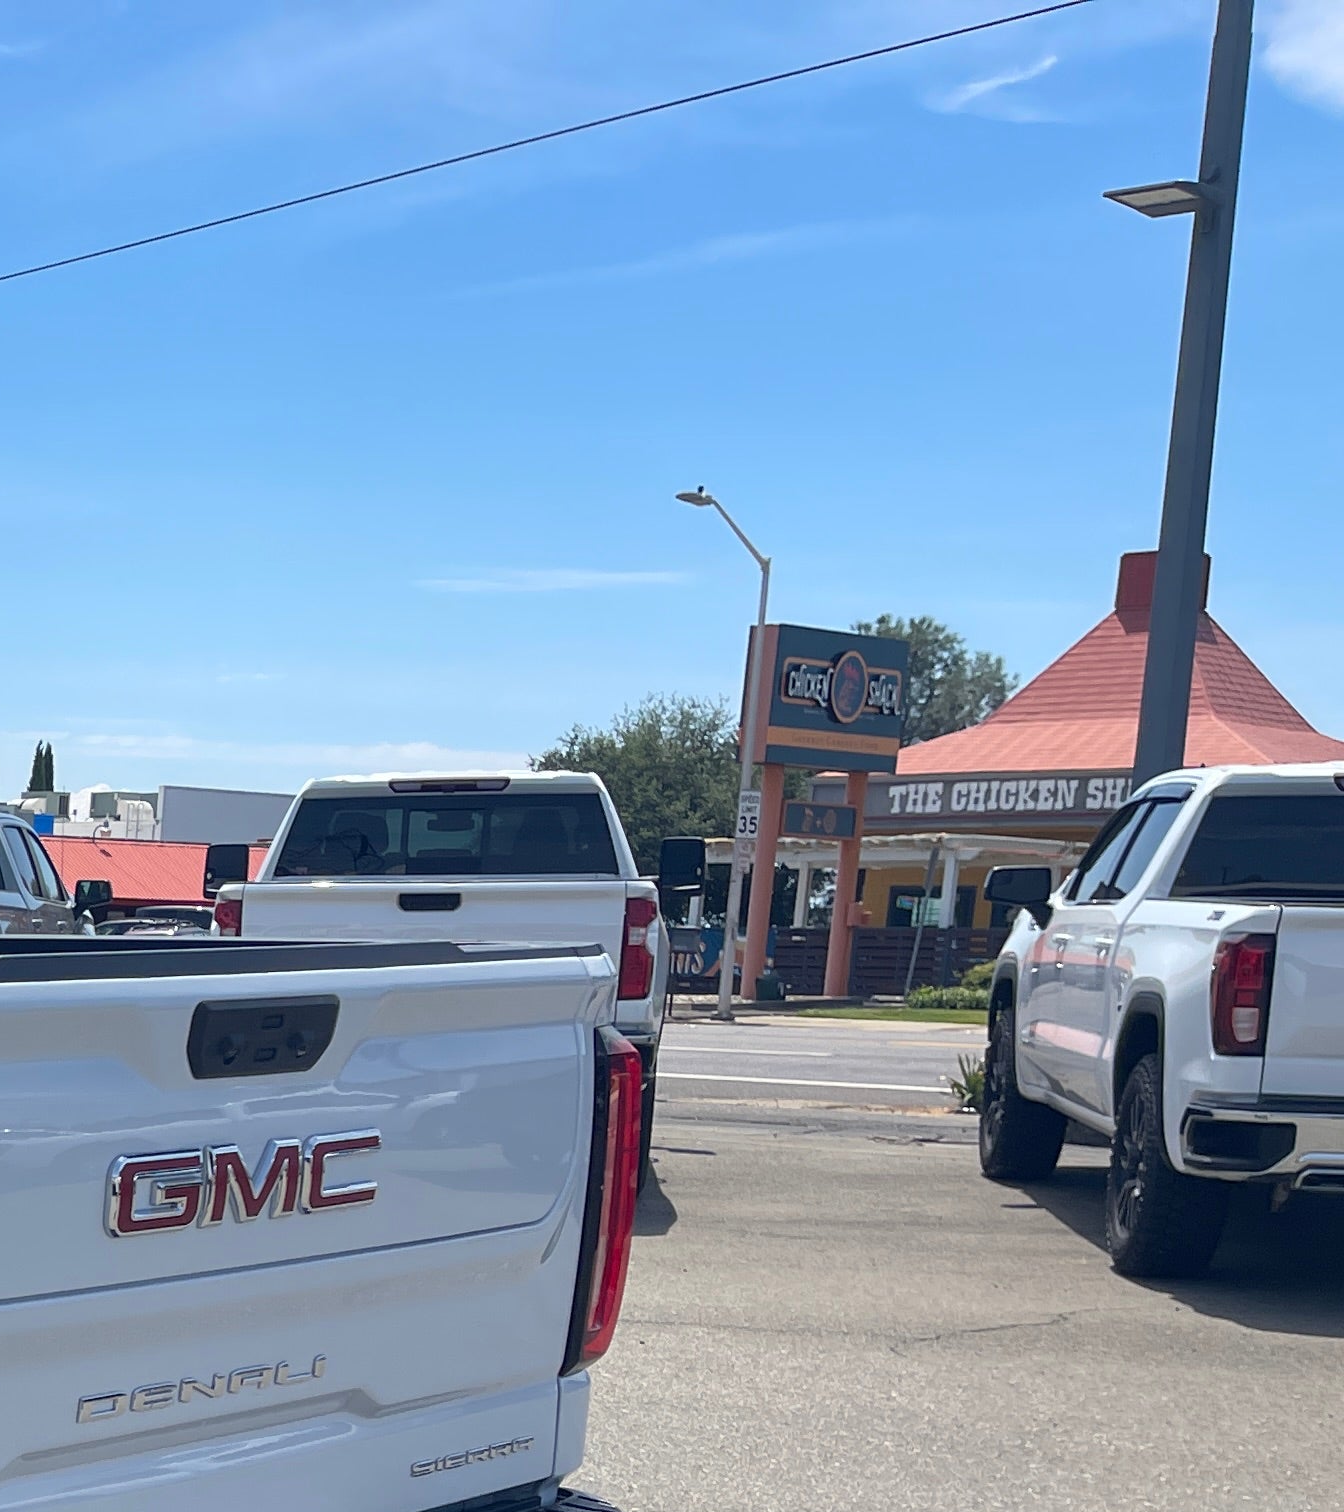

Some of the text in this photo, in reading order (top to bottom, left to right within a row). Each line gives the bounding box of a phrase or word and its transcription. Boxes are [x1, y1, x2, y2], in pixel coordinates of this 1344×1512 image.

[888, 782, 944, 814] THE
[950, 779, 1079, 812] CHICKEN
[738, 816, 758, 834] 35
[105, 1127, 381, 1239] GMC
[76, 1354, 328, 1424] DENALI
[409, 1436, 535, 1478] SIERRA
